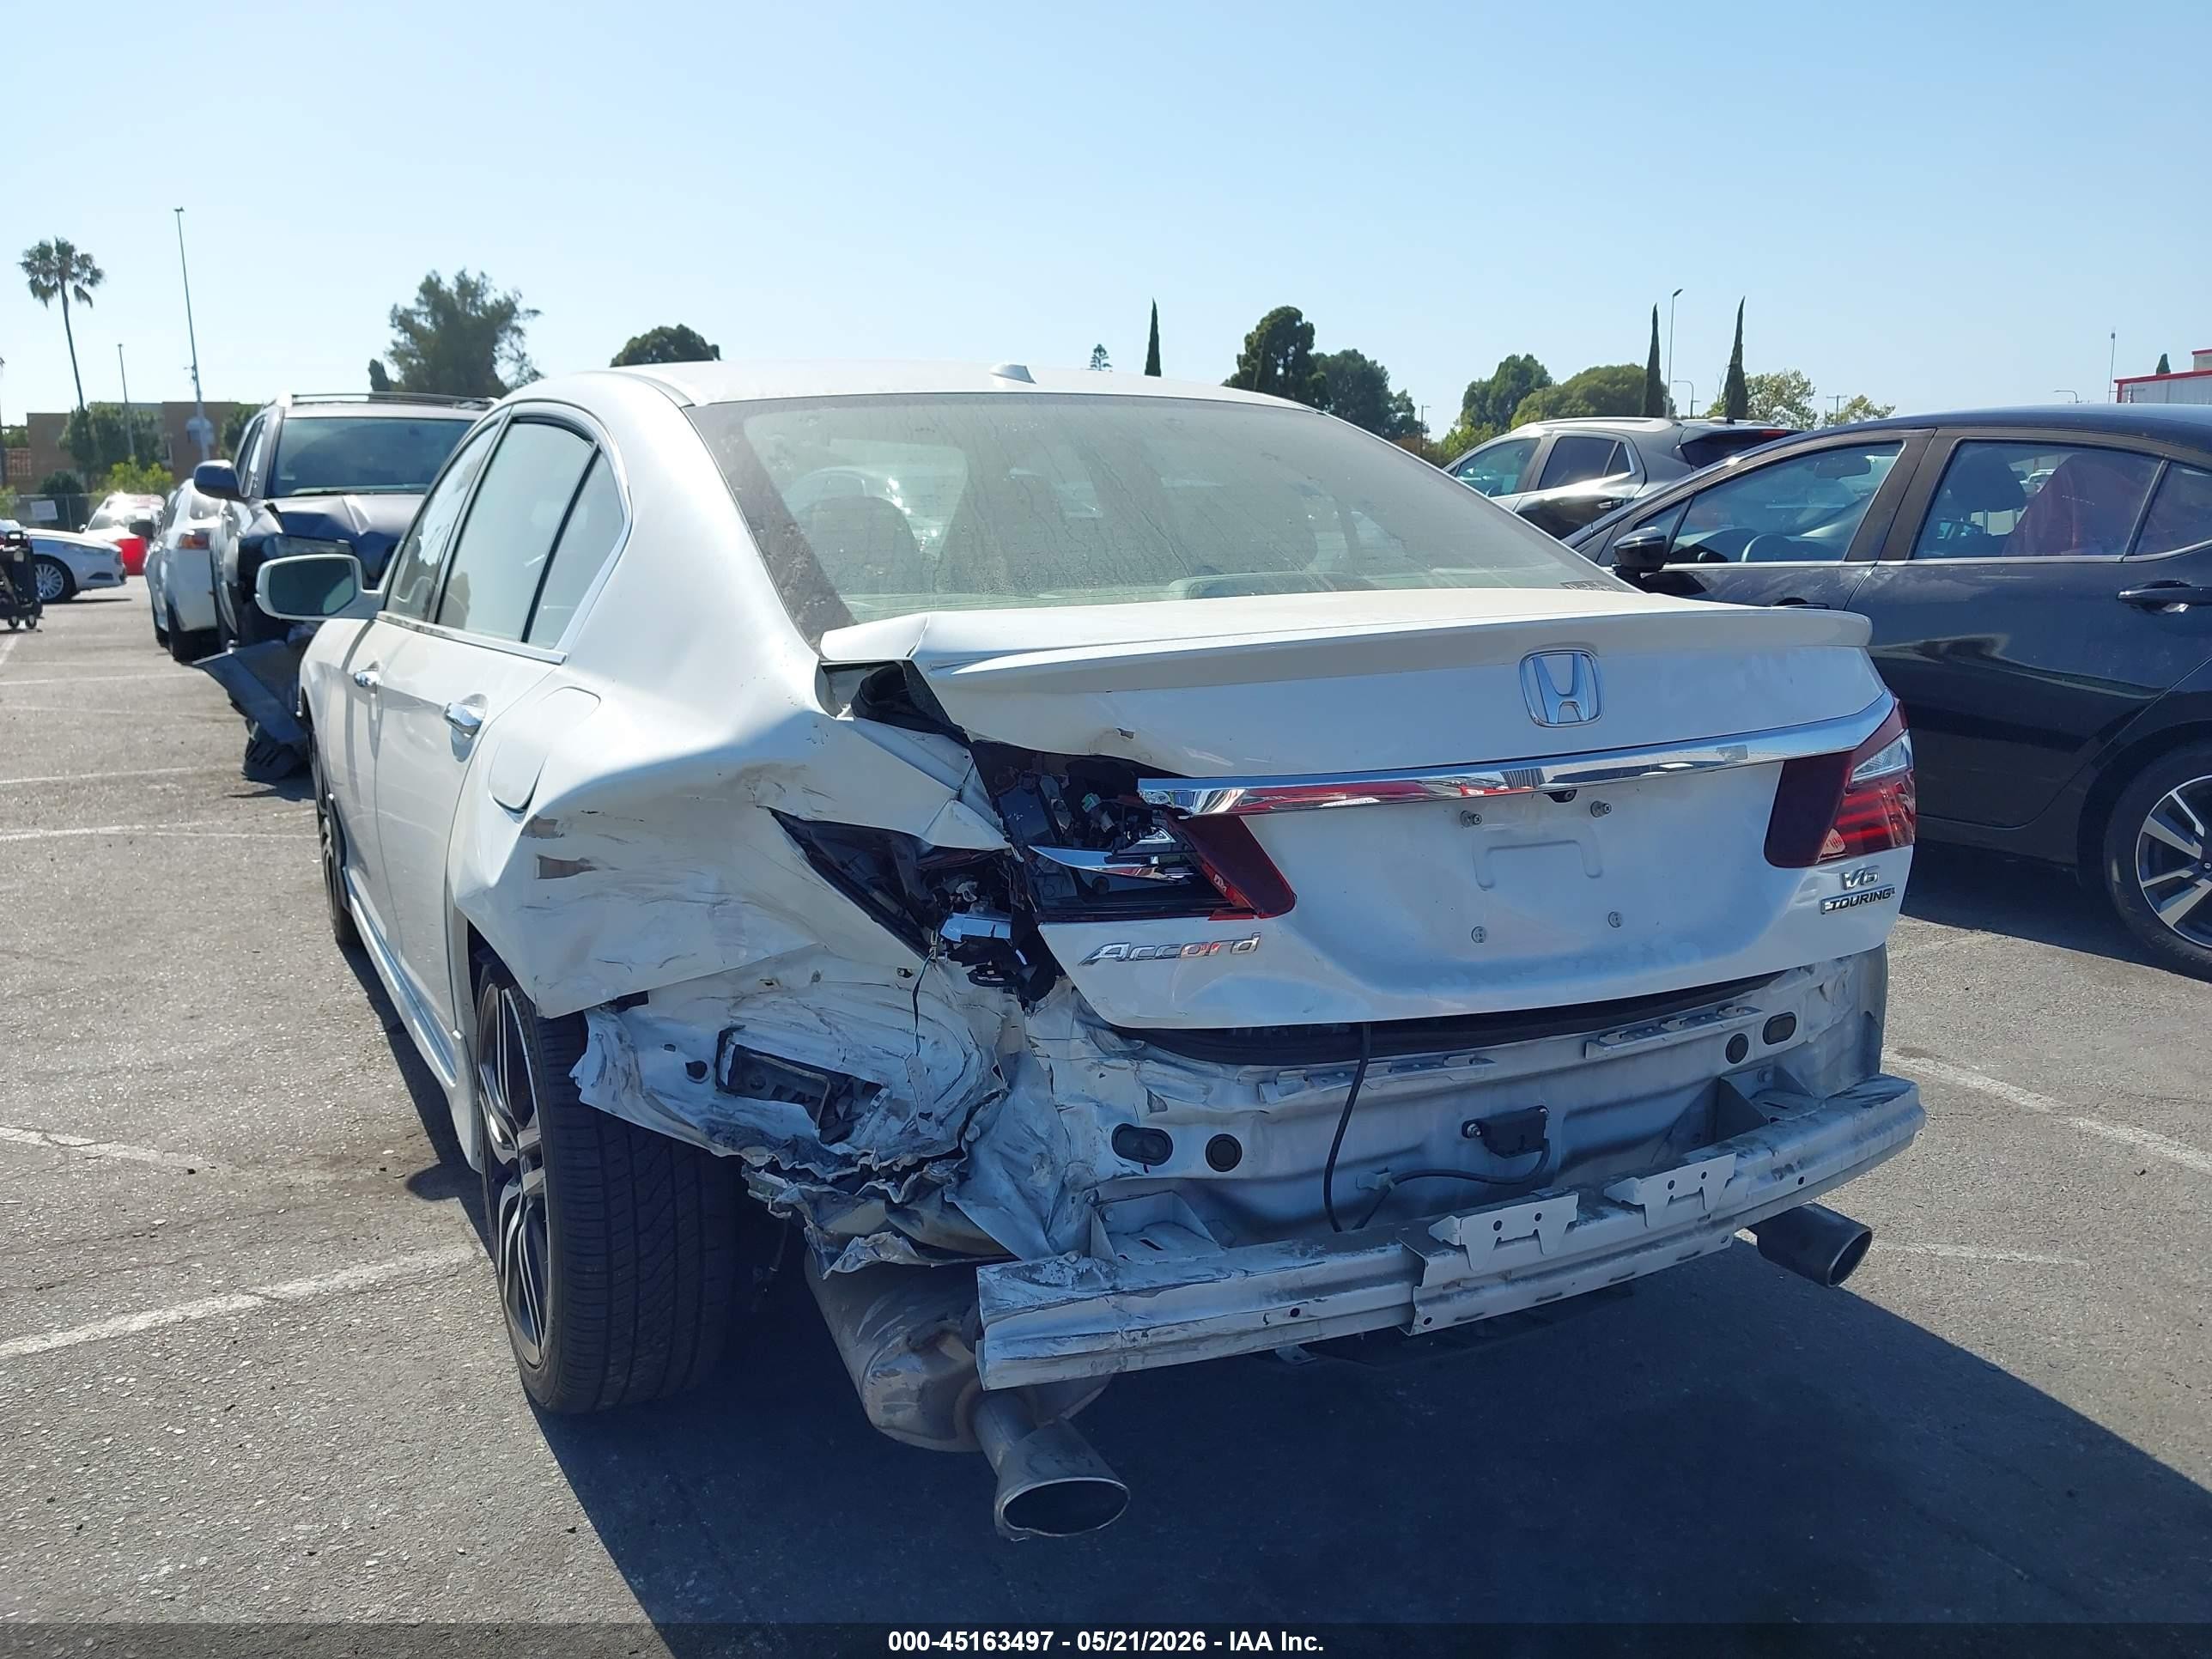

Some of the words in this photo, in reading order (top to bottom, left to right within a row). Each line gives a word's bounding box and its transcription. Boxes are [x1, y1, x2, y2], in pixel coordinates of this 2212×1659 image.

[1841, 865, 1880, 890] V6
[1824, 885, 1896, 912] TOURING
[1079, 932, 1261, 967] Accord
